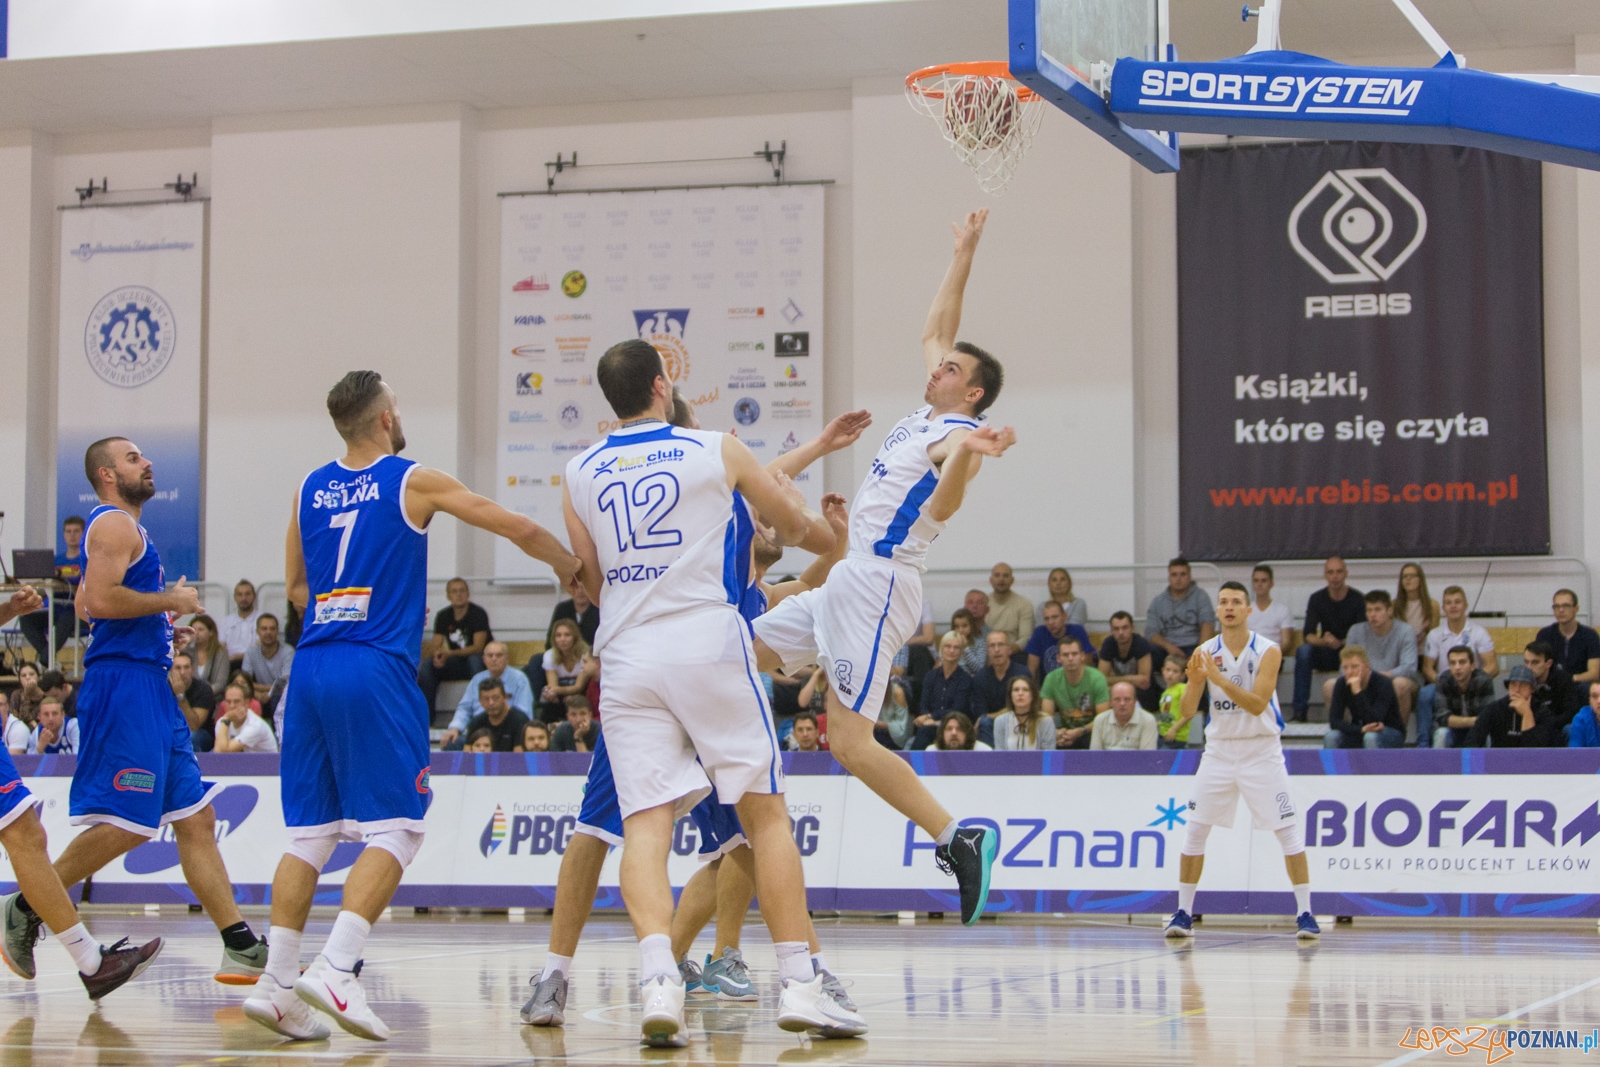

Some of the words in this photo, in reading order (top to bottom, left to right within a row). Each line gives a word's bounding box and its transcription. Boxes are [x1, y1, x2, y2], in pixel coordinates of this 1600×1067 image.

[1304, 292, 1412, 318] REBIS
[1235, 371, 1368, 404] Książki,
[1235, 417, 1325, 444] które
[1335, 415, 1386, 446] się
[1396, 412, 1489, 445] czyta
[617, 448, 685, 469] funclub
[619, 463, 643, 472] biuro
[1209, 475, 1519, 507] www.rebis.com.pl
[598, 471, 683, 553] 12
[329, 509, 360, 584] 7
[513, 802, 580, 815] fundacja
[1275, 793, 1292, 812] 2
[508, 815, 578, 856] PBG
[1328, 857, 1391, 870] POLSKI
[1404, 857, 1516, 870] PRODUCENT
[1527, 855, 1591, 870] LEKÓW
